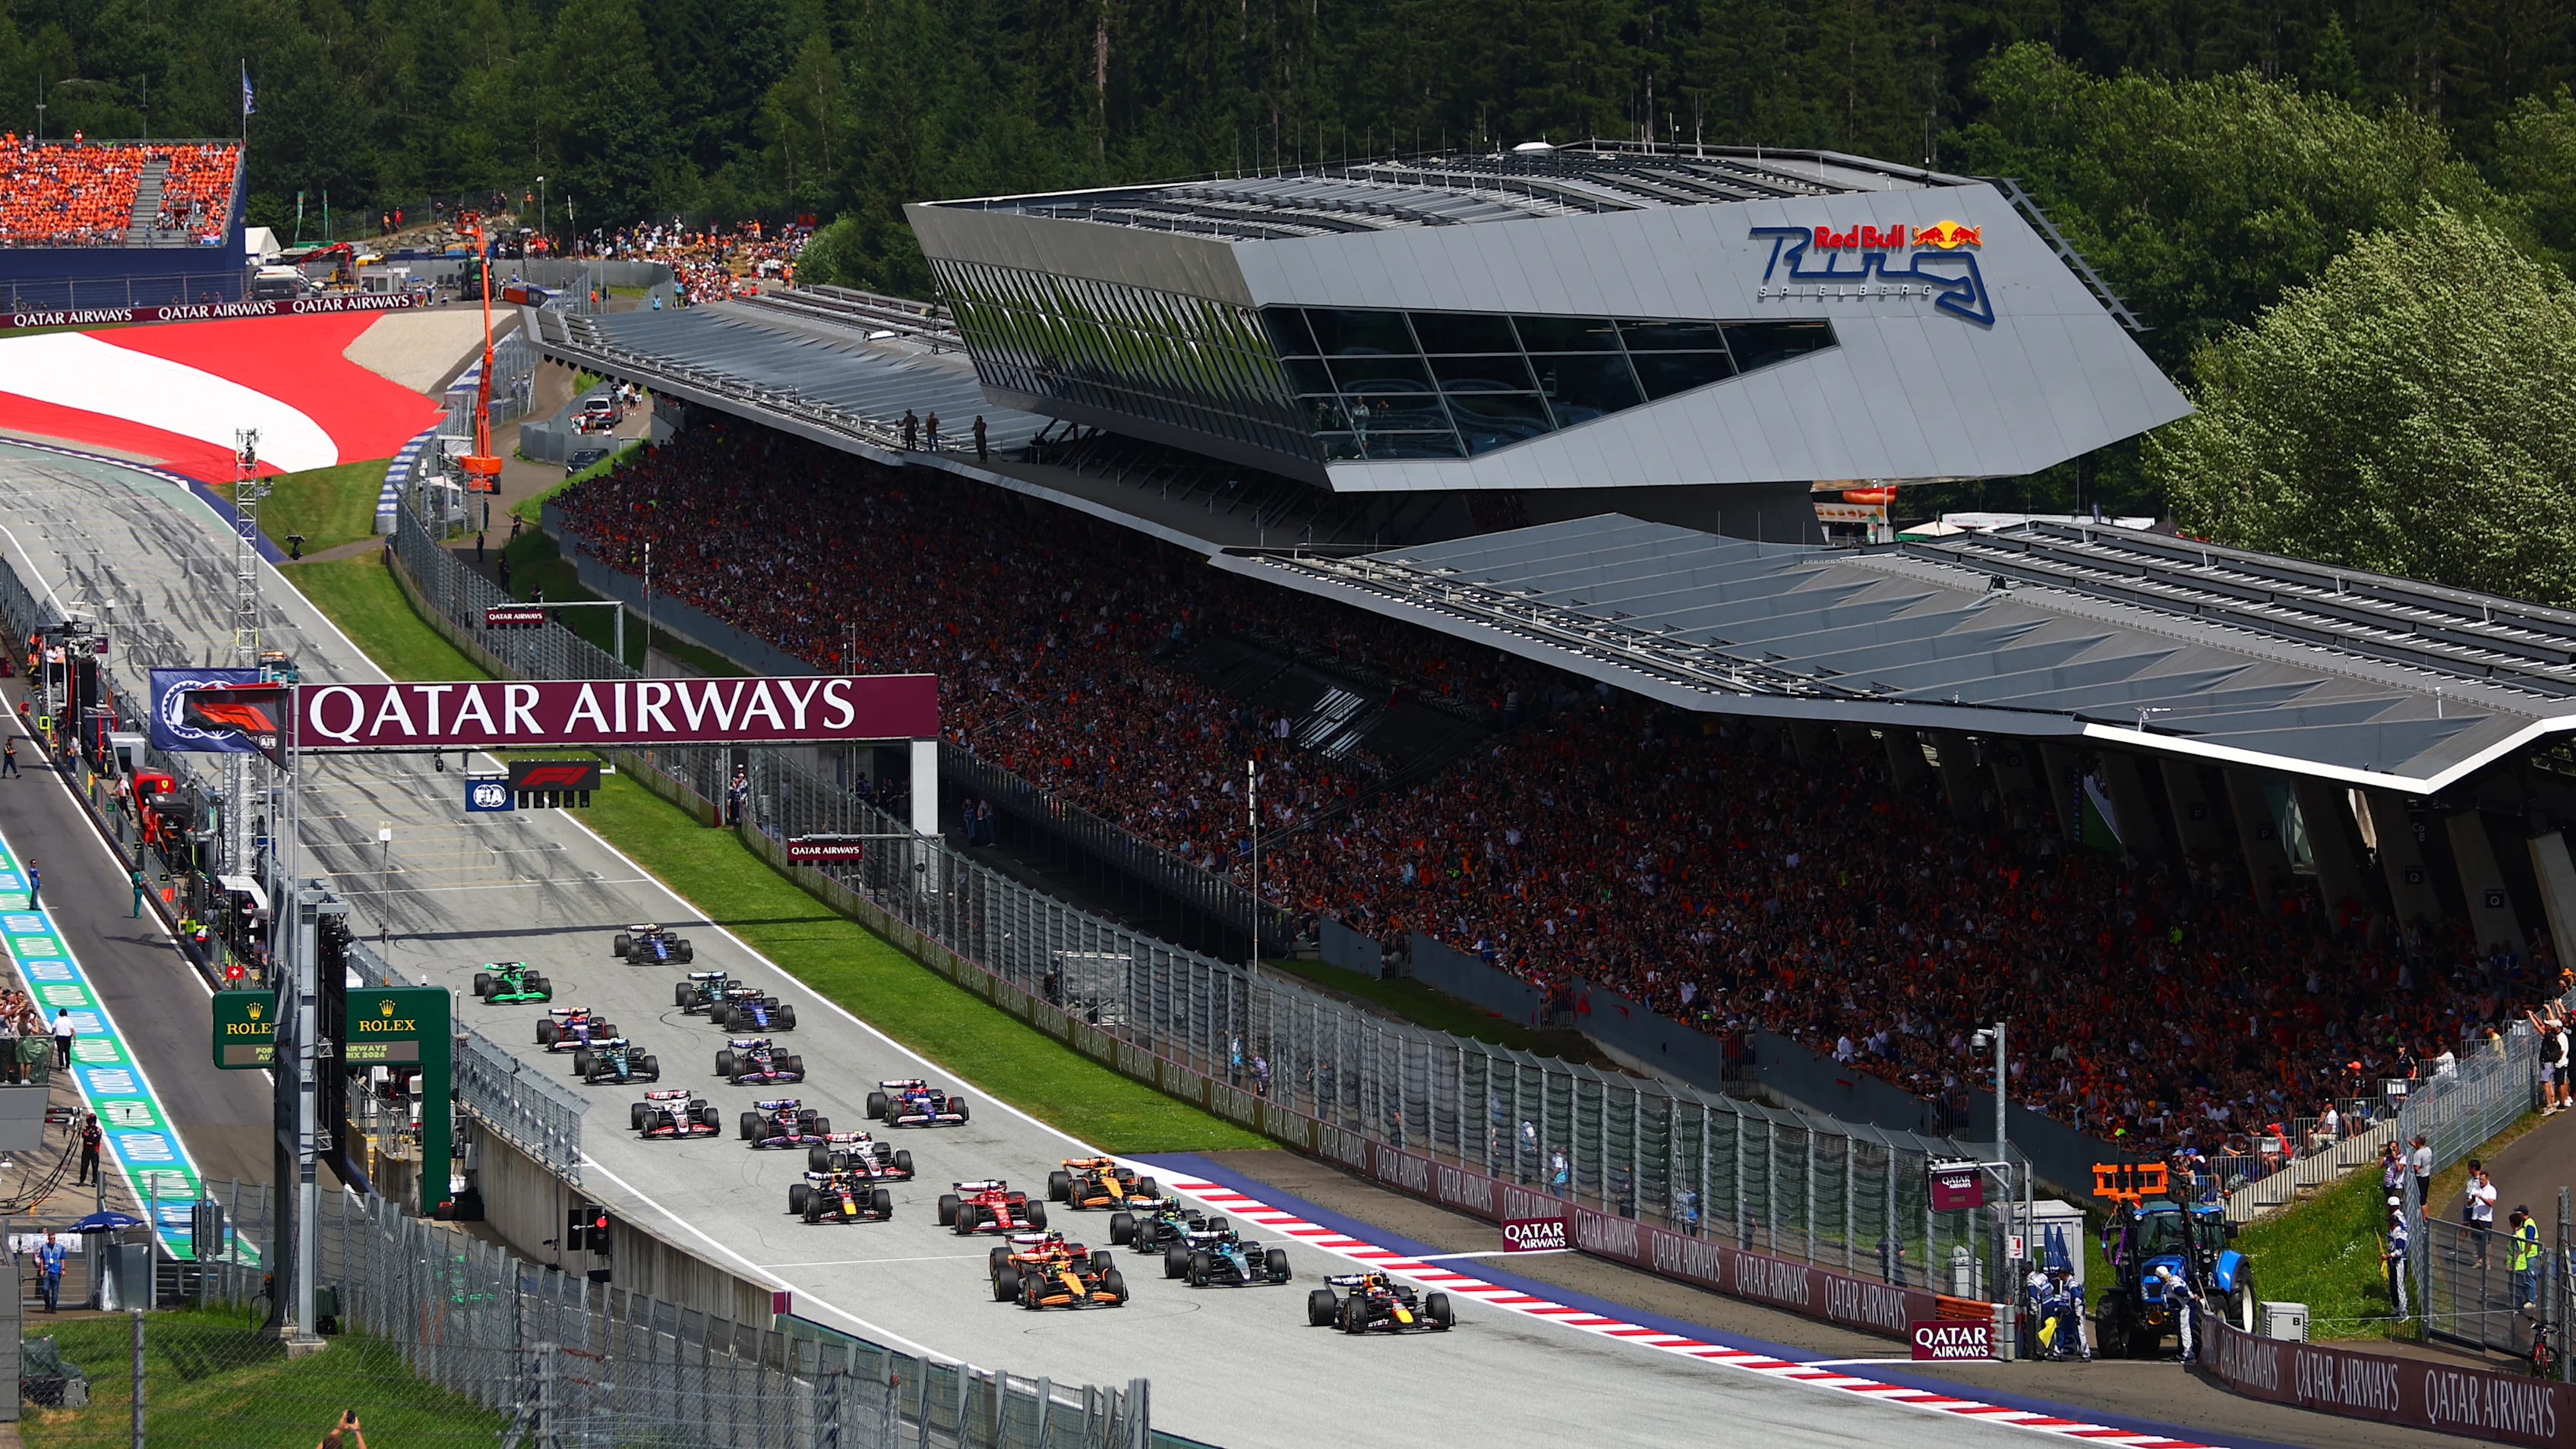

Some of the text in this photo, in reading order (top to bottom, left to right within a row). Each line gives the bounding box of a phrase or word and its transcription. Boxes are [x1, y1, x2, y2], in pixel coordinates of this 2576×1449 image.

[1814, 224, 1905, 248] Red Bull
[1758, 284, 1932, 298] SPIELBERG
[158, 301, 276, 320] QATAR AIRWAYS
[292, 295, 410, 314] QATAR AIRWAYS
[14, 309, 133, 327] QATAR AIRWAYS
[309, 679, 856, 743] QATAR AIRWAYS
[791, 846, 860, 855] QATAR AIRWAYS
[2410, 873, 2420, 882] Q
[2490, 896, 2500, 905] Q
[226, 1023, 275, 1035] ROLE
[358, 1019, 417, 1032] ROLEX
[1211, 1081, 1255, 1125] QATAR AIRWAYS
[1263, 1101, 1310, 1148] QATAR AIRWAYS
[1317, 1122, 1367, 1170] QATAR AIRWAYS
[1375, 1145, 1428, 1193] QATAR AIRWAYS
[1942, 1175, 1971, 1185] QATAR
[1438, 1166, 1493, 1213] QATAR AIRWAYS
[1504, 1222, 1564, 1242] QATAR
[1519, 1237, 1566, 1249] AIRWAYS
[1575, 1208, 1639, 1260] QATAR AIRWAYS
[1652, 1230, 1721, 1283] QATAR AIRWAYS
[1735, 1252, 1809, 1306] QATAR AIRWAYS
[1825, 1275, 1906, 1331] QATAR AIRWAYS
[2293, 1317, 2300, 1326] B
[1915, 1327, 1987, 1350] QATAR
[1932, 1345, 1988, 1358] AIRWAYS
[2220, 1329, 2240, 1381] QATAR
[2240, 1337, 2278, 1391] AIRWAYS
[2295, 1349, 2400, 1412] QATAR AIRWAYS
[2425, 1369, 2556, 1439] QATAR AIRWAYS
